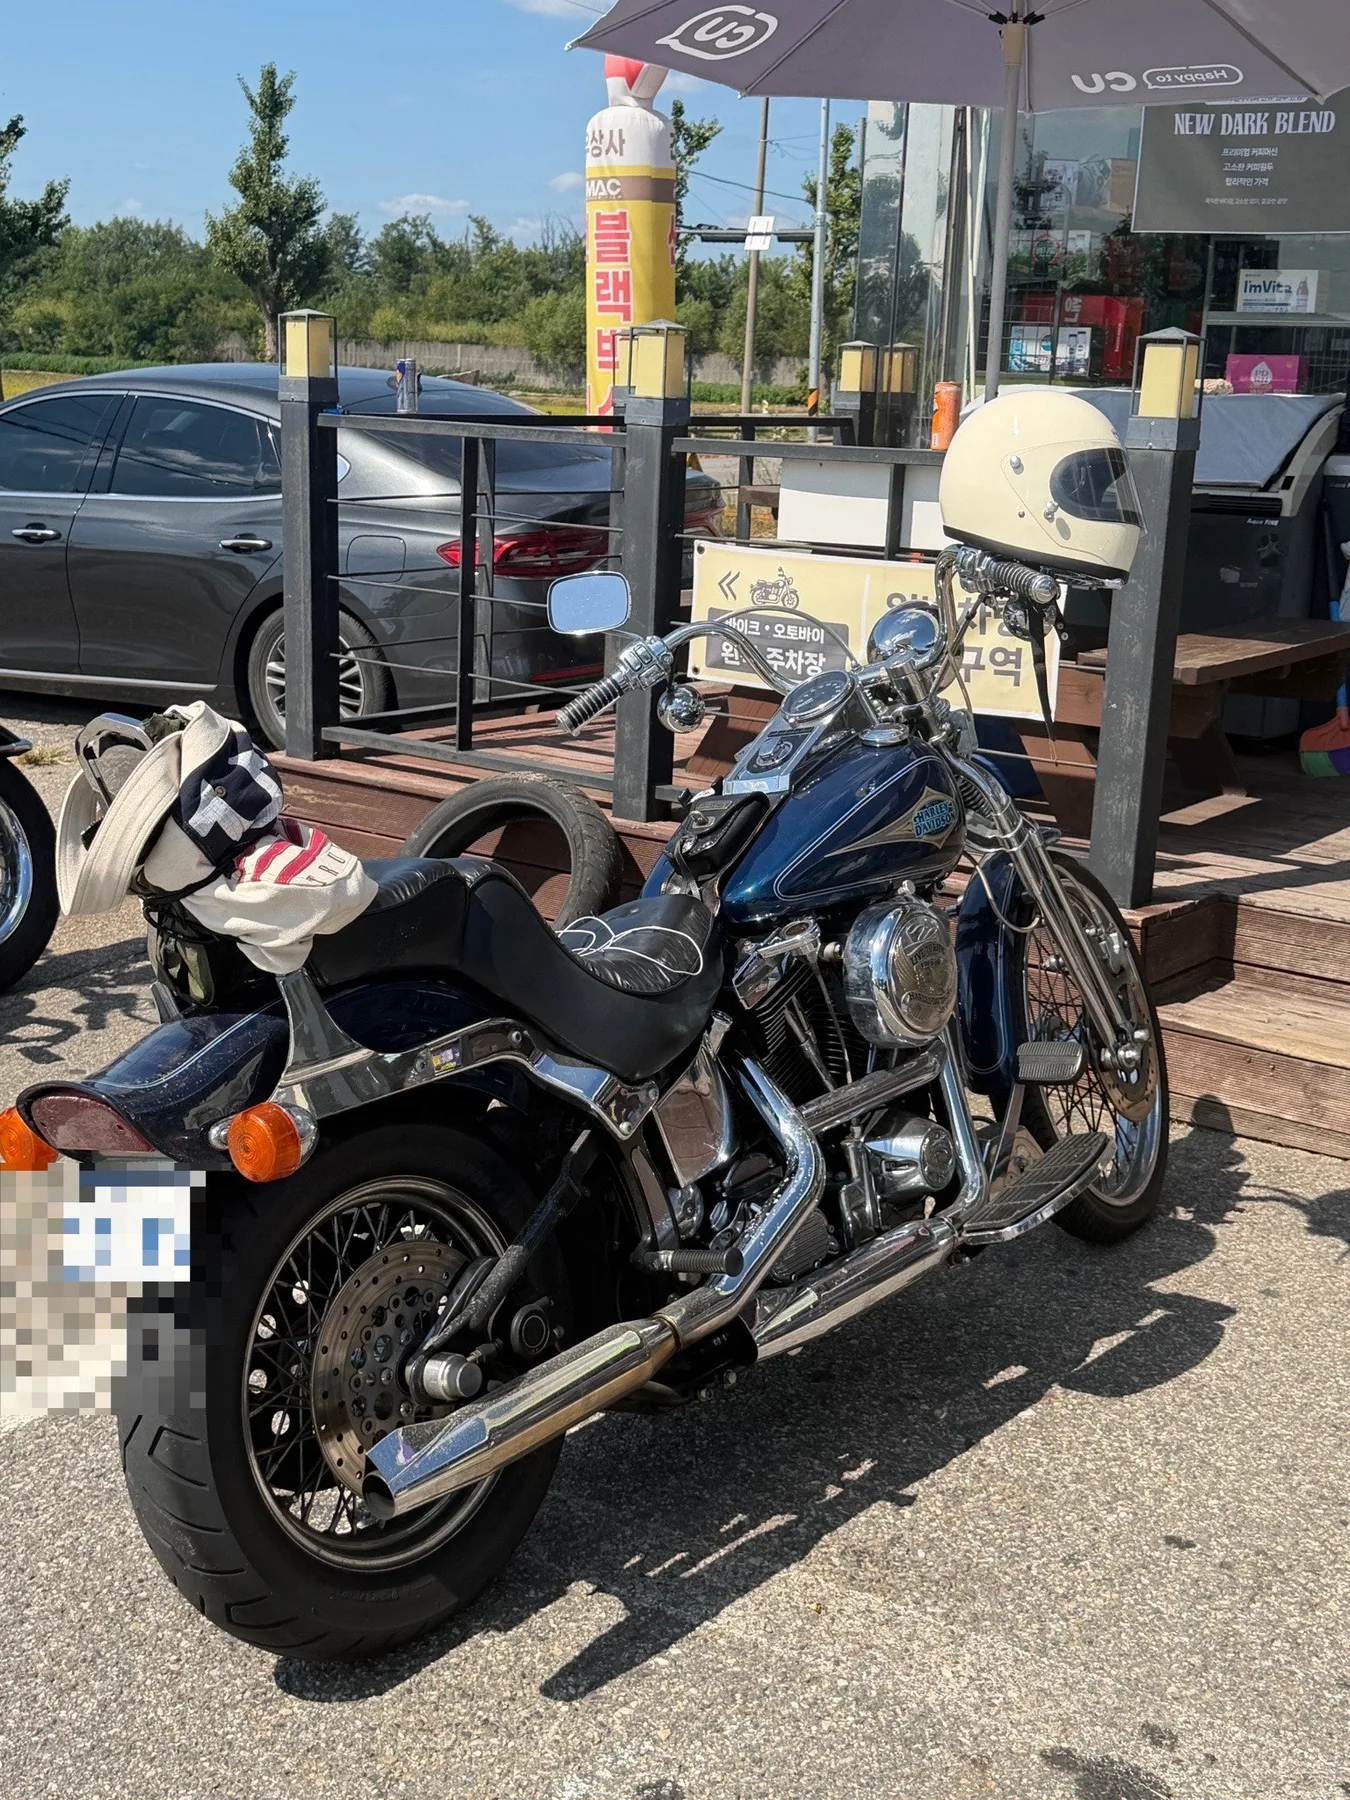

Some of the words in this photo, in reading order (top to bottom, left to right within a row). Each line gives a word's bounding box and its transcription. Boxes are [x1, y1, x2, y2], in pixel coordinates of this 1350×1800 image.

[1174, 112, 1215, 135] NEW
[1219, 112, 1269, 136] DARK
[1274, 110, 1336, 134] BLEND
[586, 128, 626, 158] 상사
[772, 623, 825, 644] 오토바이
[766, 647, 826, 676] 주차장
[915, 812, 956, 837] DAVIDSON
